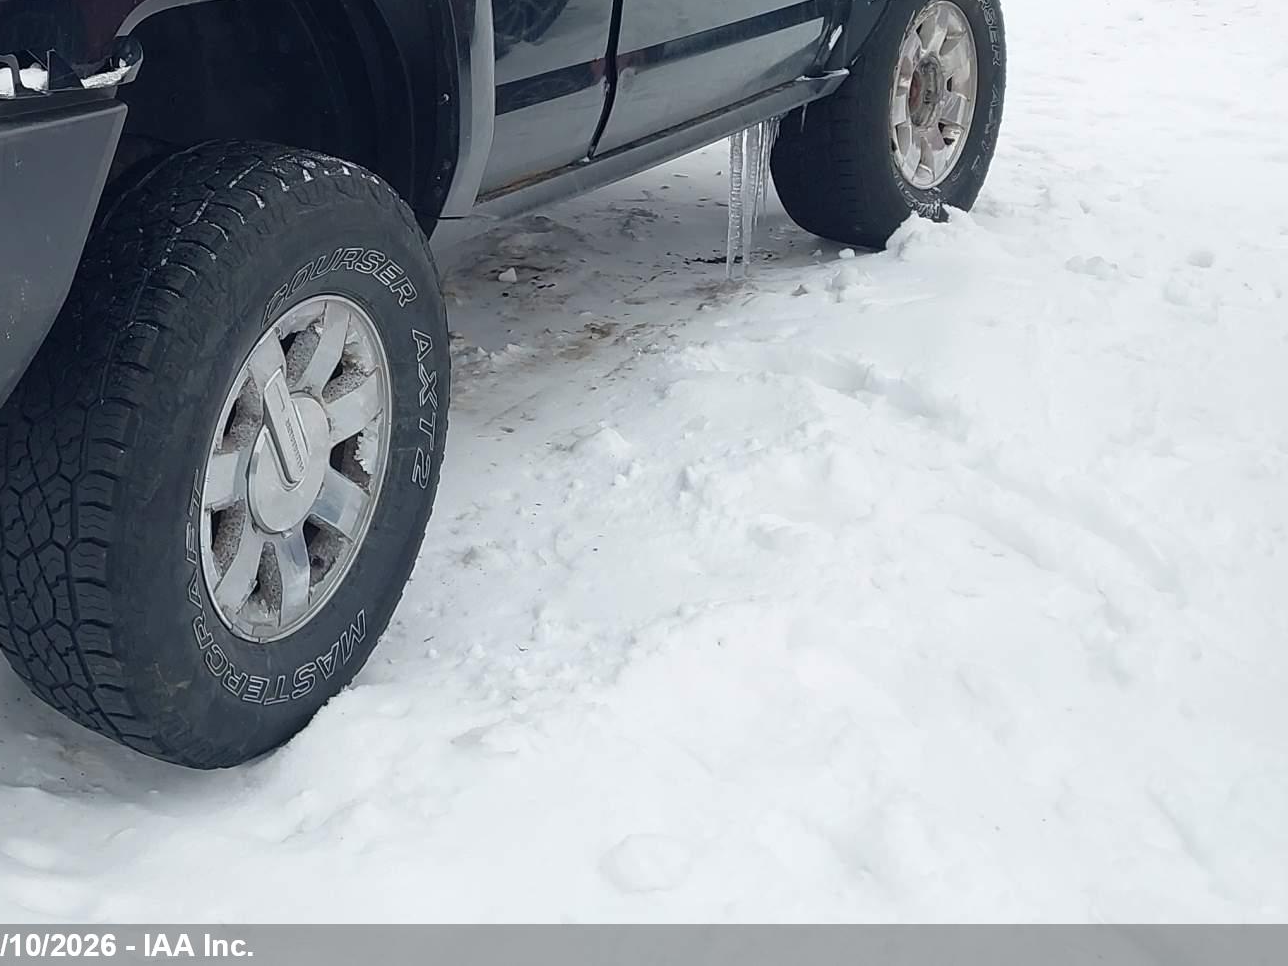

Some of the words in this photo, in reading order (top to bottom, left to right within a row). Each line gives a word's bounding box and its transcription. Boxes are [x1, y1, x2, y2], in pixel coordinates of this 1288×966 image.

[261, 247, 418, 328] COURSER
[410, 328, 442, 492] AXT2
[185, 468, 367, 706] MASTERCRAFT
